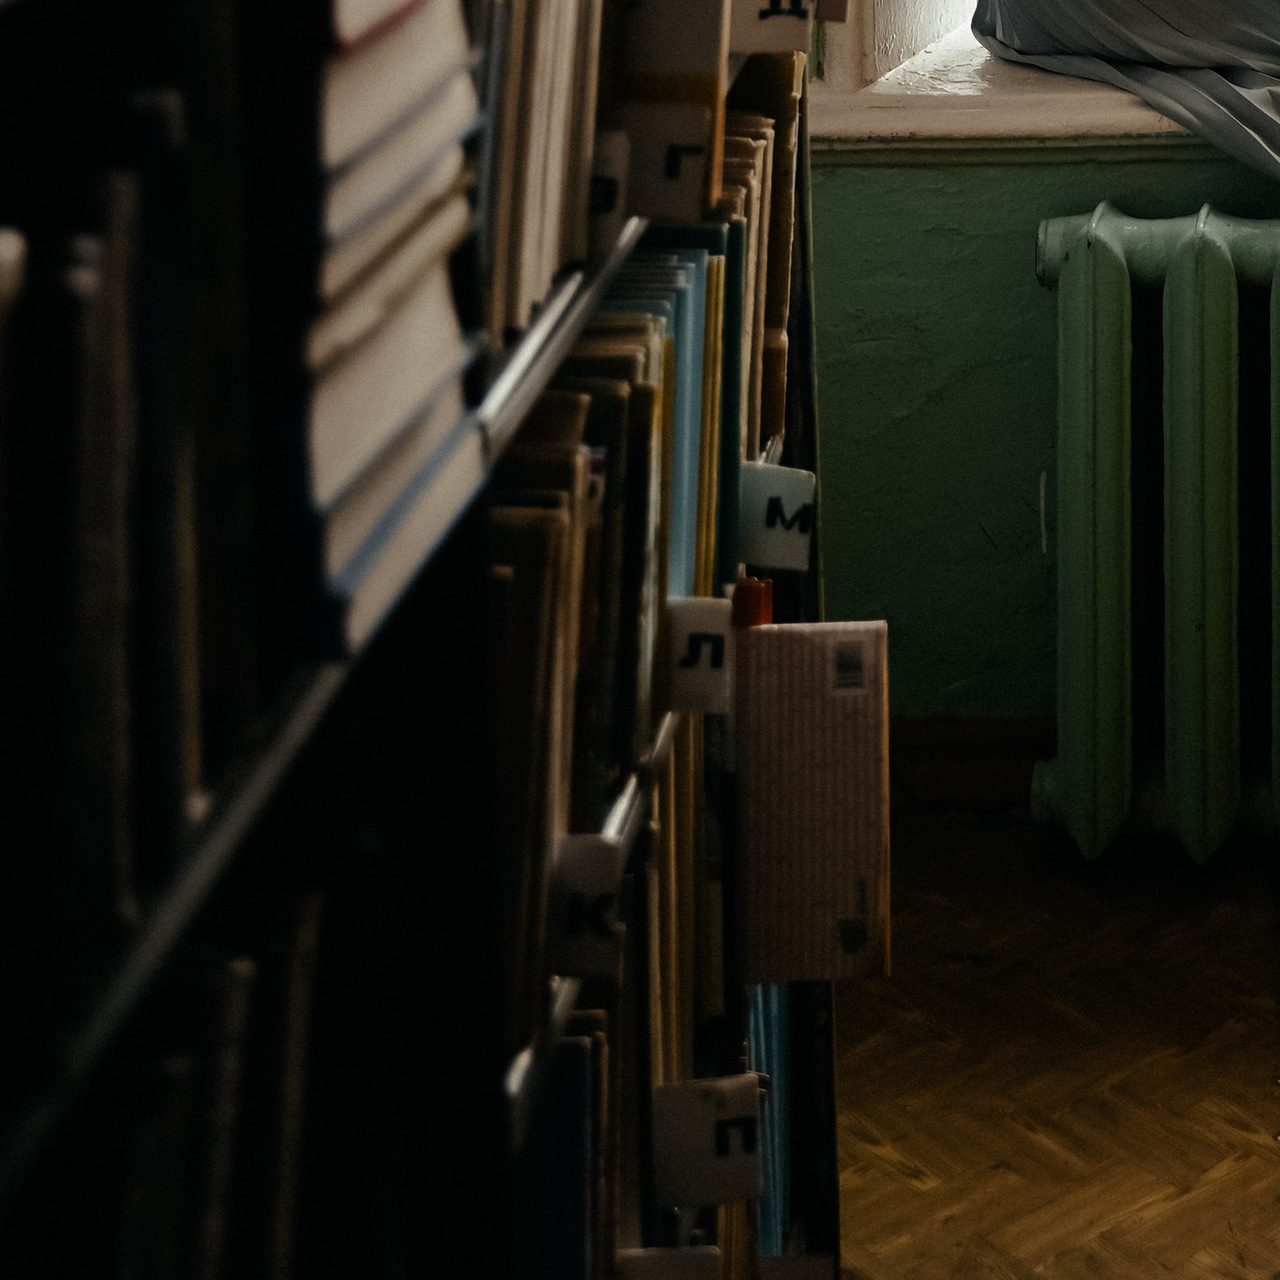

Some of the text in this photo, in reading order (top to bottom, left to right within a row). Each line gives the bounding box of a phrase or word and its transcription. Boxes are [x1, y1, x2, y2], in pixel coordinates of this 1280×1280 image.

[666, 144, 705, 182] Г
[765, 496, 813, 534] М
[679, 631, 725, 669] Л
[715, 1116, 758, 1159] П
